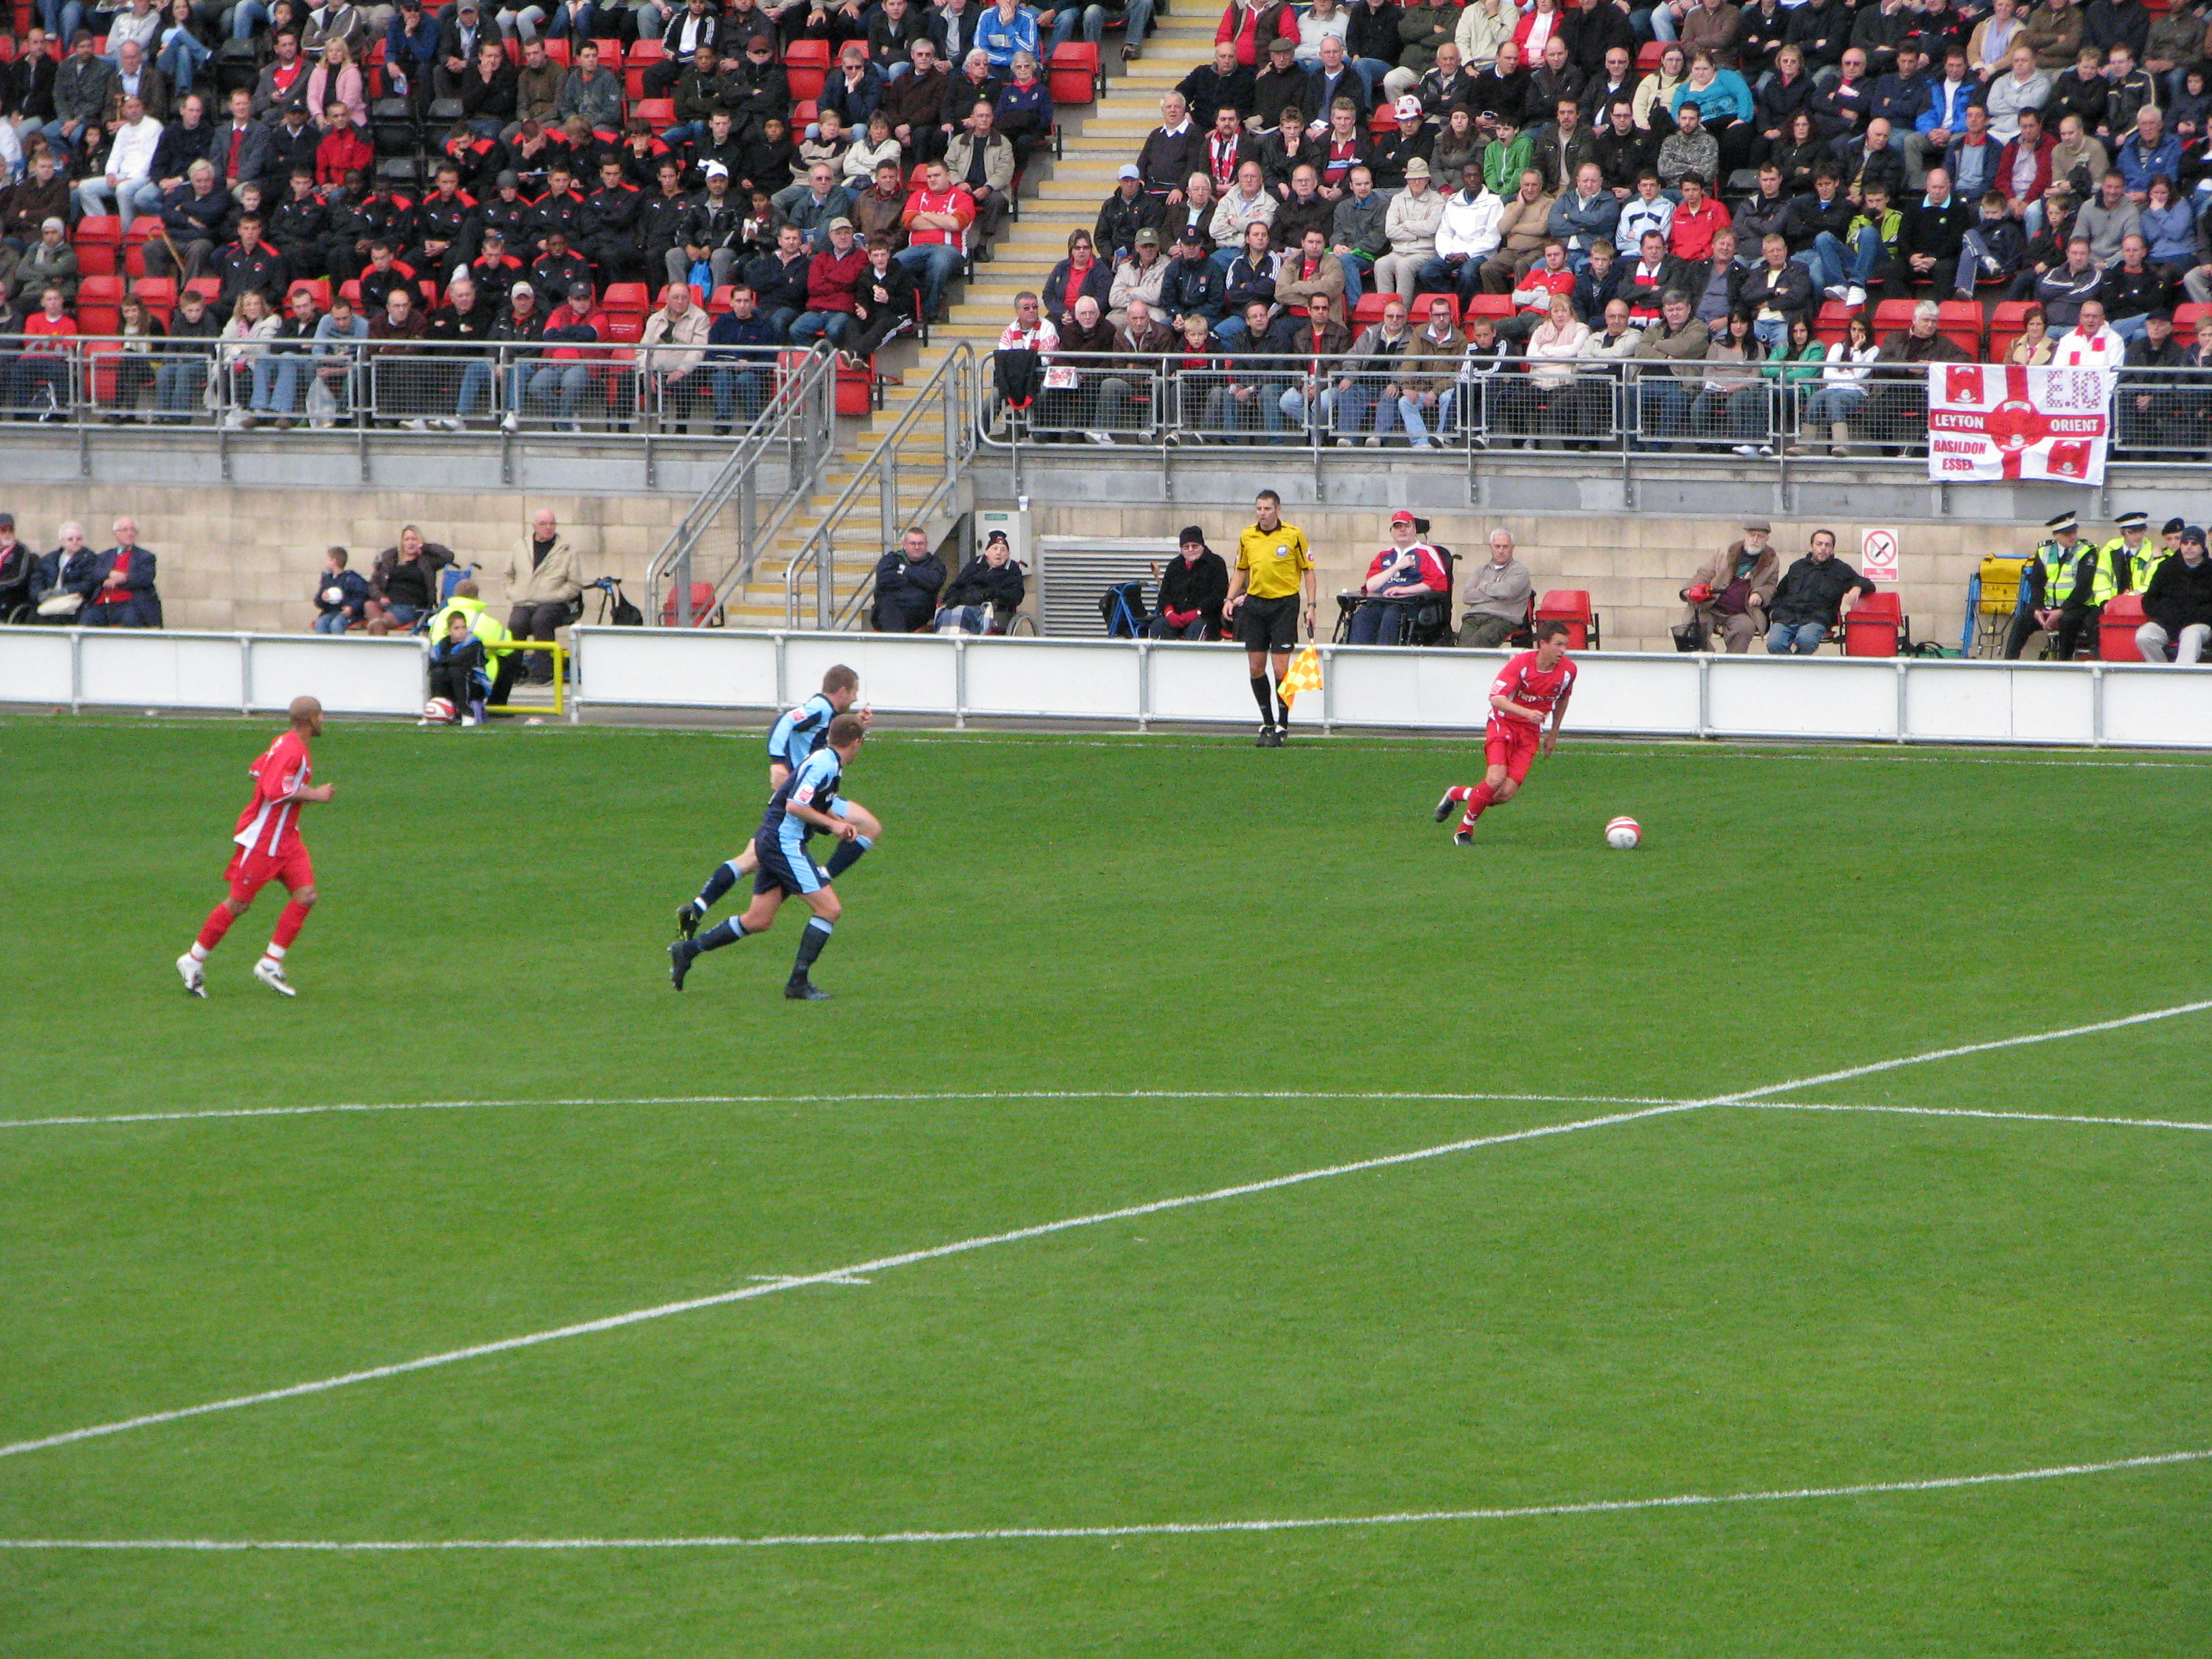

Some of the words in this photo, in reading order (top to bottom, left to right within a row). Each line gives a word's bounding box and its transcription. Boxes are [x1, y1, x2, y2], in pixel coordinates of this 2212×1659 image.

[1935, 414, 1984, 430] LEYTON
[2050, 419, 2099, 432] ORIENT
[1933, 440, 1987, 455] BASILDON
